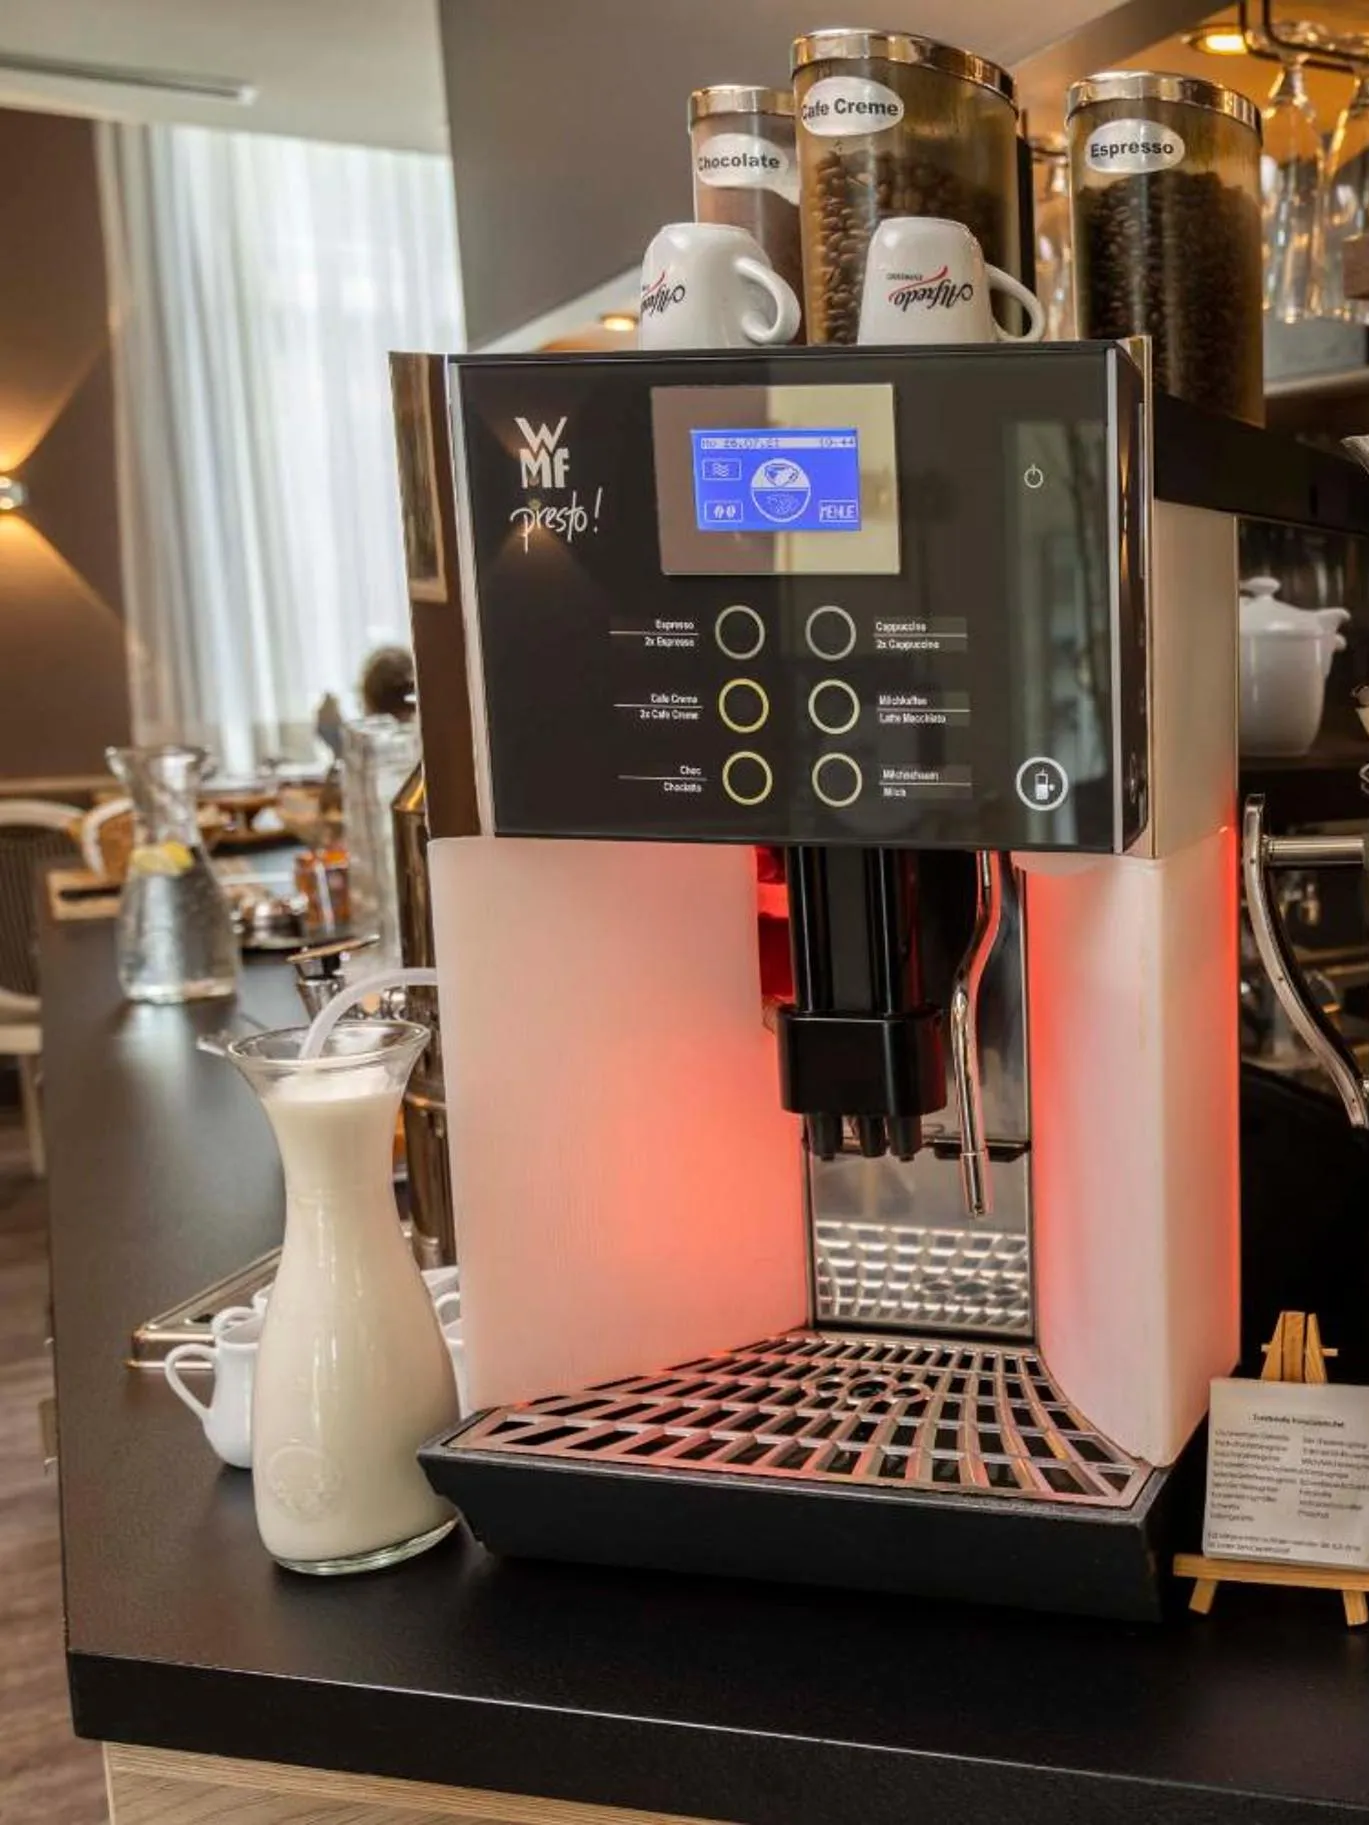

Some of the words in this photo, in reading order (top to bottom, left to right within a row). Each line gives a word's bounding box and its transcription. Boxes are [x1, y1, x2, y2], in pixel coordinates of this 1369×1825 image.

[801, 100, 830, 120] Cafe
[834, 97, 900, 117] Creme
[1090, 142, 1175, 158] Espresso
[698, 152, 781, 171] Chocolate
[889, 278, 975, 312] Alfredo
[513, 415, 571, 489] WMF
[875, 621, 927, 633] Cappuccino
[656, 637, 695, 648] Espresso
[888, 639, 940, 651] Cappuccino
